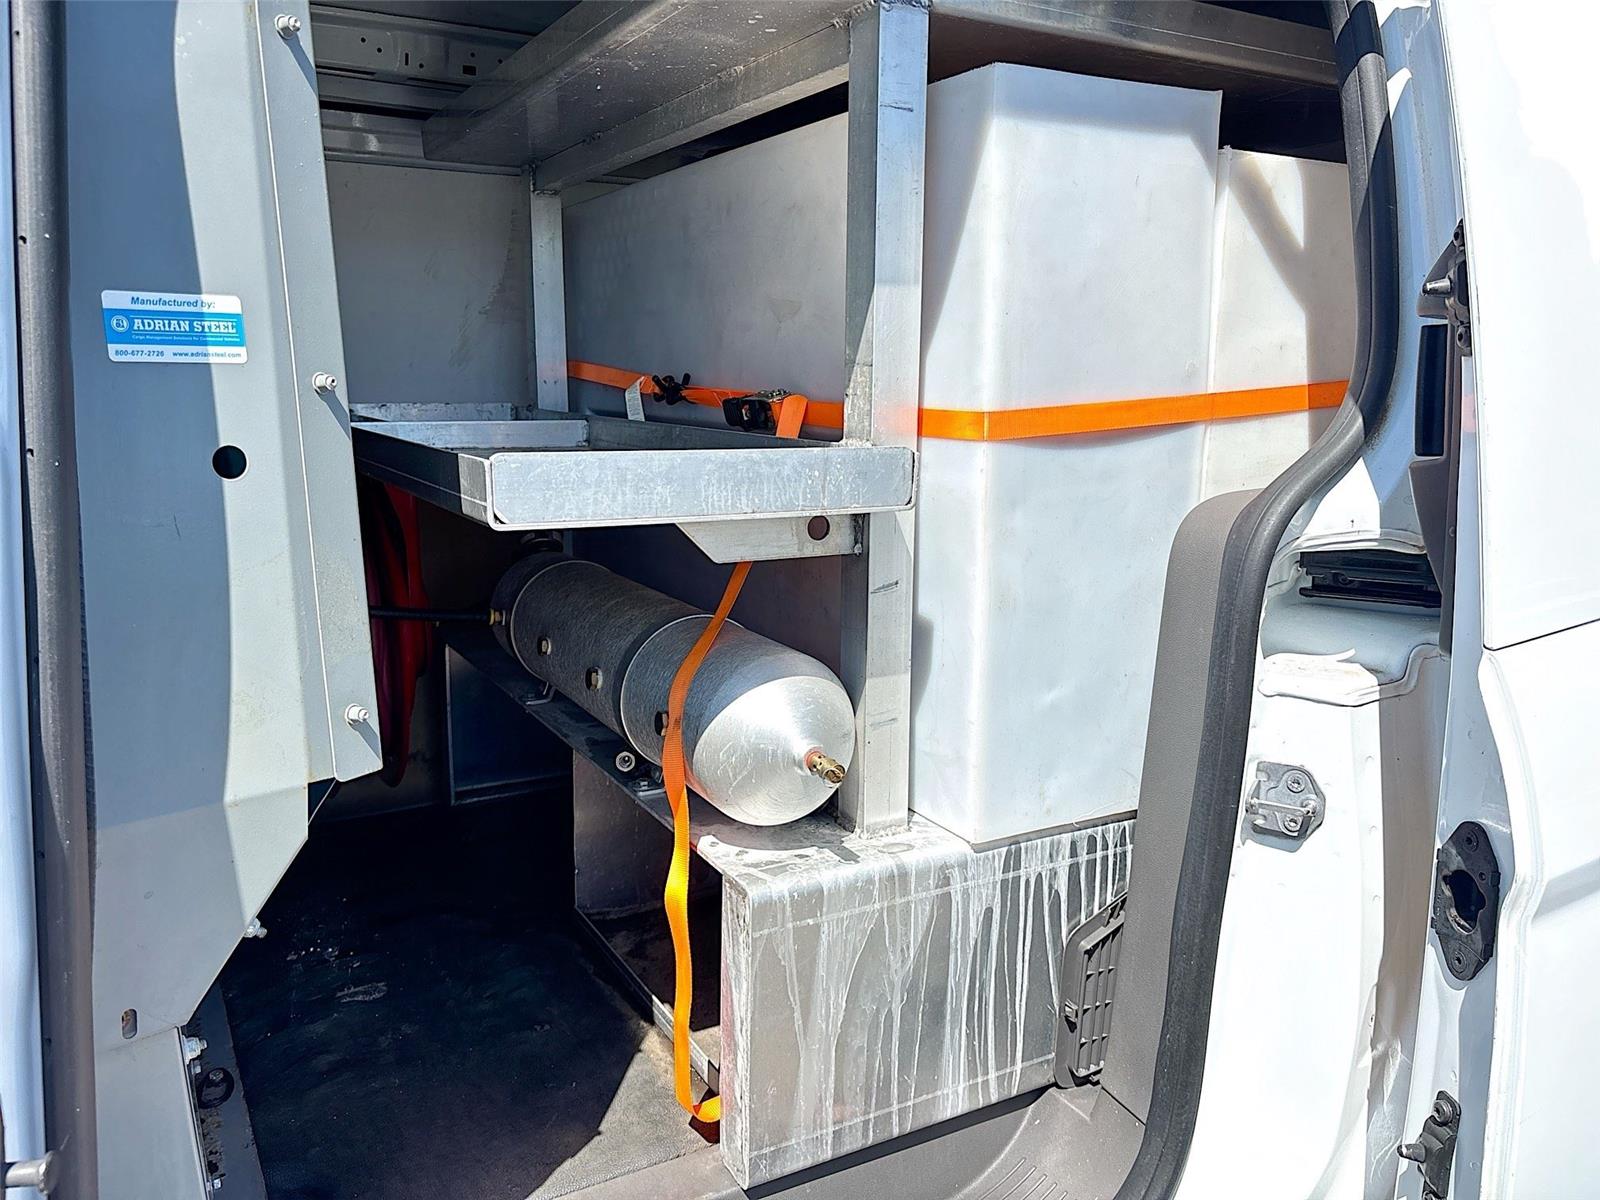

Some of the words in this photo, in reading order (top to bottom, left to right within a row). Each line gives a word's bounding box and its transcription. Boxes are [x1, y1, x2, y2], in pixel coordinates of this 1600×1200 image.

[131, 296, 198, 307] Manufactured
[201, 300, 216, 309] by:
[133, 318, 190, 332] ADRIAN
[194, 321, 237, 334] STEEL
[114, 349, 165, 357] 800-677-2726
[172, 350, 242, 358] www.adriansteel.com
